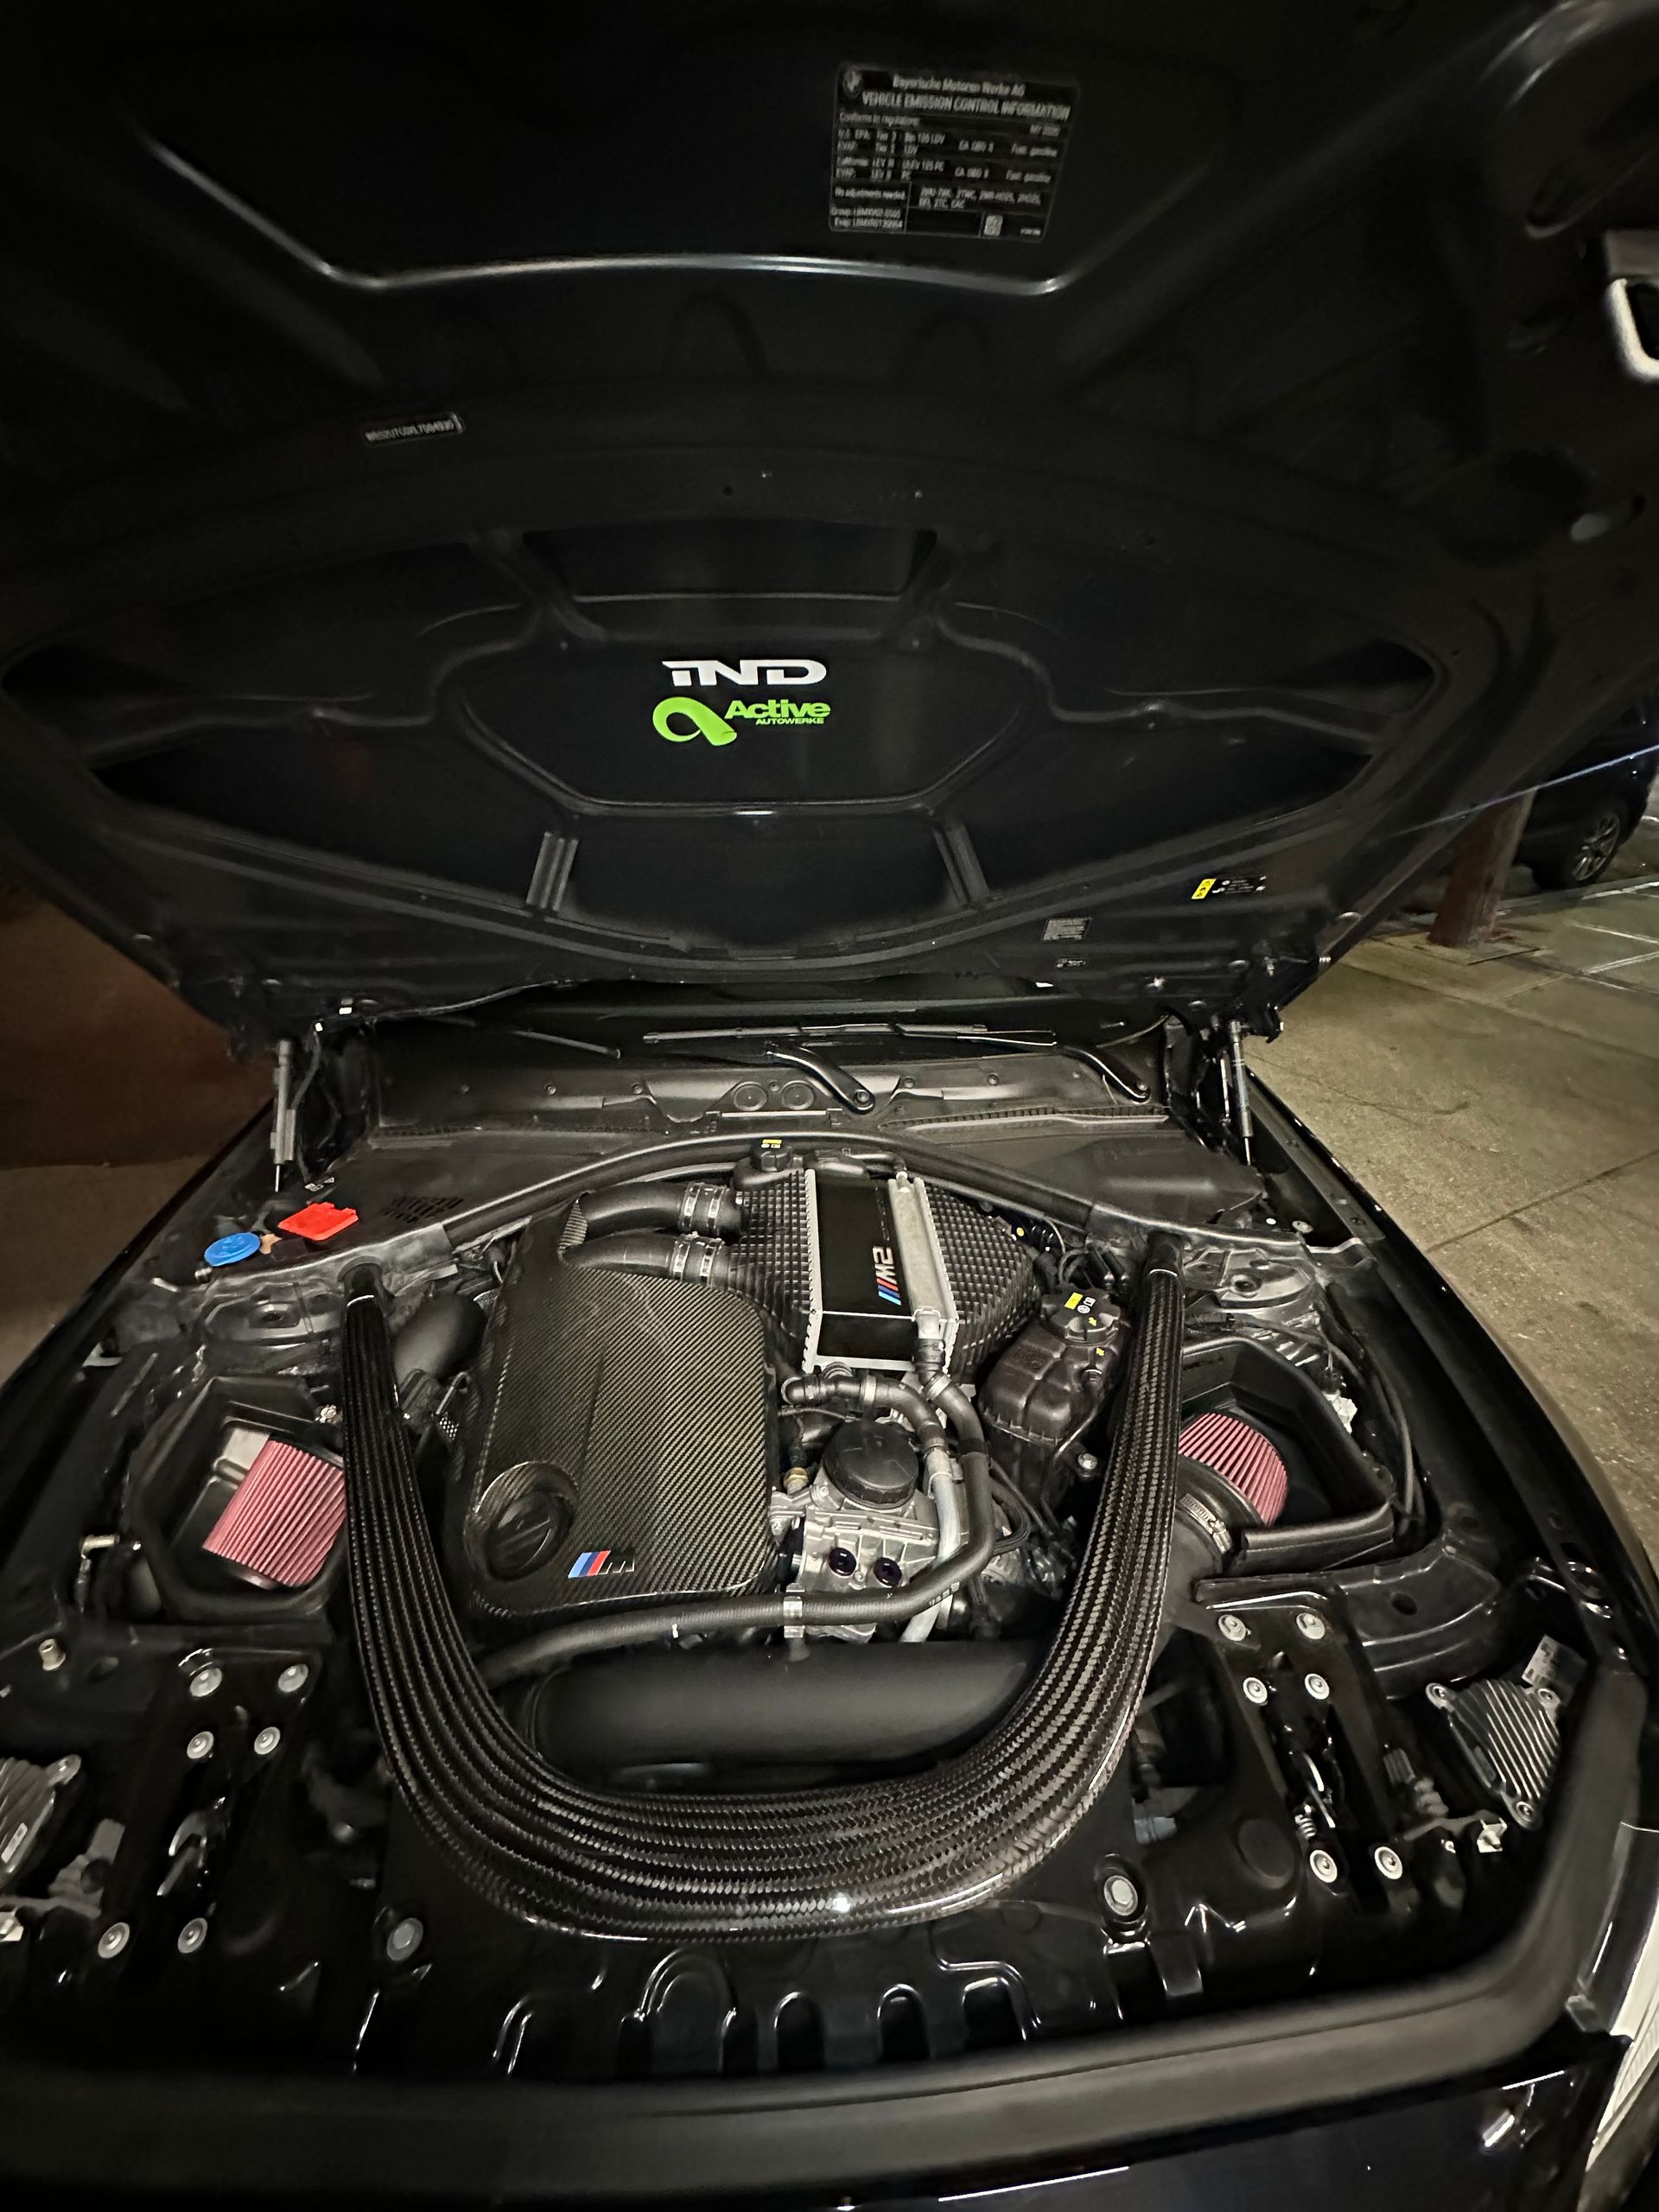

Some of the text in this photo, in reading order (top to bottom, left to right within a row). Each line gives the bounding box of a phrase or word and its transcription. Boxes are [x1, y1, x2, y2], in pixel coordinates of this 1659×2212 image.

[862, 92, 1071, 121] VEHICLE EMISSION CONTROL INFORMATION
[724, 699, 831, 720] Active
[755, 717, 825, 726] AUTOWERKE
